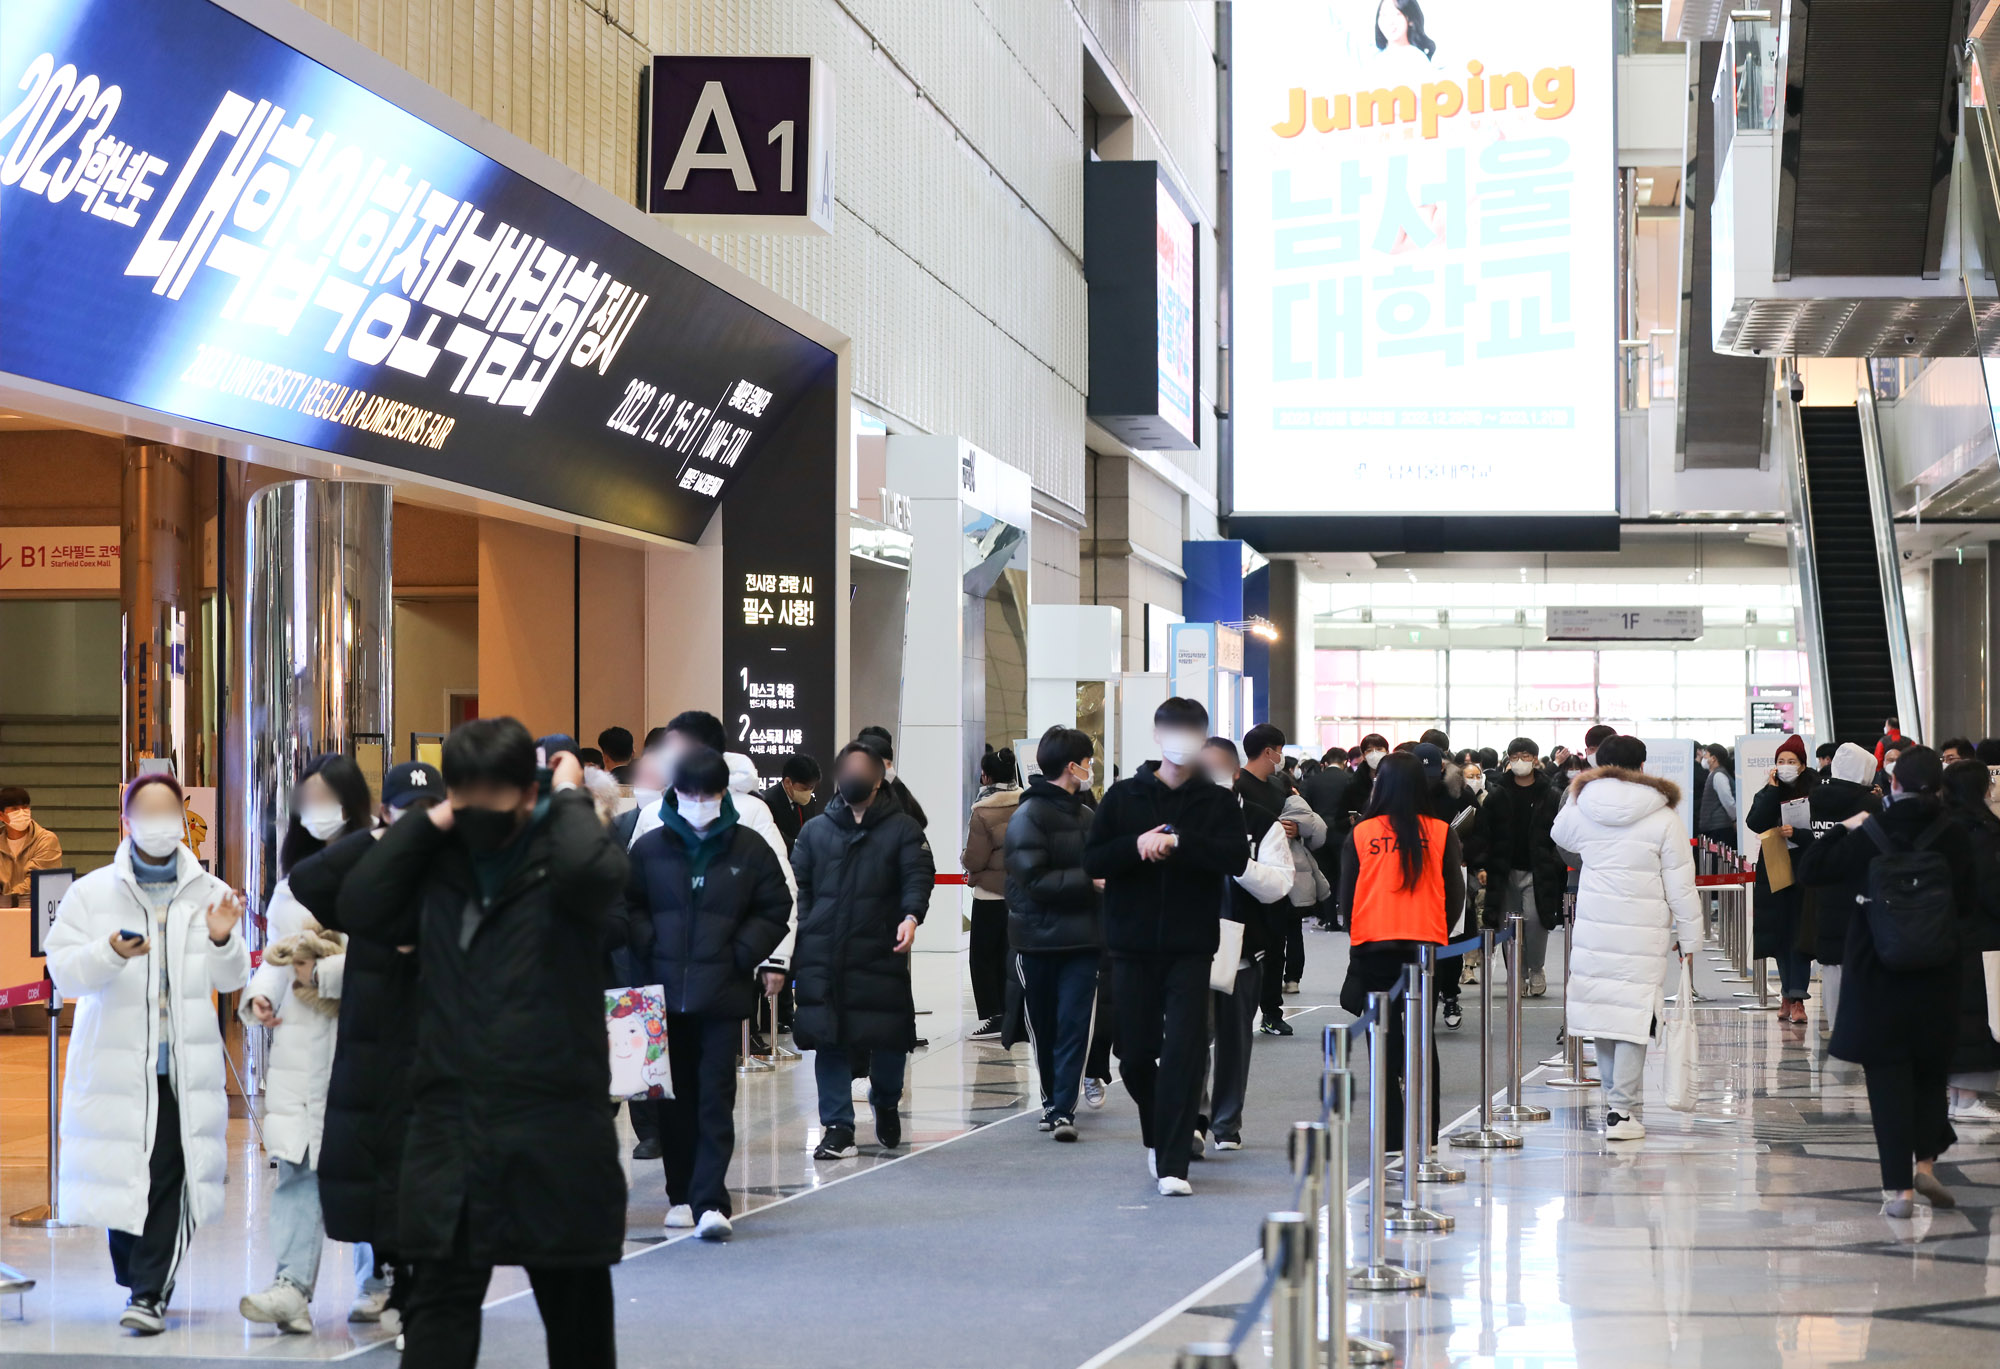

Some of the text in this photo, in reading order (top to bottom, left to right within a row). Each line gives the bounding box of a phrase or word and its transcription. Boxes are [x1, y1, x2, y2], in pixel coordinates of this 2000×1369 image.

[1271, 59, 1575, 139] Jumping
[664, 81, 795, 192] A1
[1272, 136, 1575, 271] 남서울
[1272, 252, 1575, 382] 대학교
[219, 352, 313, 411] UNIVERSITY
[299, 377, 366, 426] REGULAR
[353, 394, 433, 445] ADMISSIONS
[420, 411, 456, 450] FAIR
[21, 546, 46, 567] B1
[51, 545, 120, 559] 스타필드 코엑
[51, 560, 78, 568] Starfield
[745, 573, 813, 594] 전시장 관람 시
[743, 598, 815, 626] 필수 사항!
[1621, 612, 1640, 630] 1F
[740, 667, 748, 691] 1
[749, 683, 795, 699] 마스크 착용
[749, 699, 766, 709] 반드시
[1548, 696, 1589, 713] Gate
[739, 714, 751, 742] 2
[749, 729, 802, 745] 손소독제 사용
[1811, 820, 1842, 830] UND
